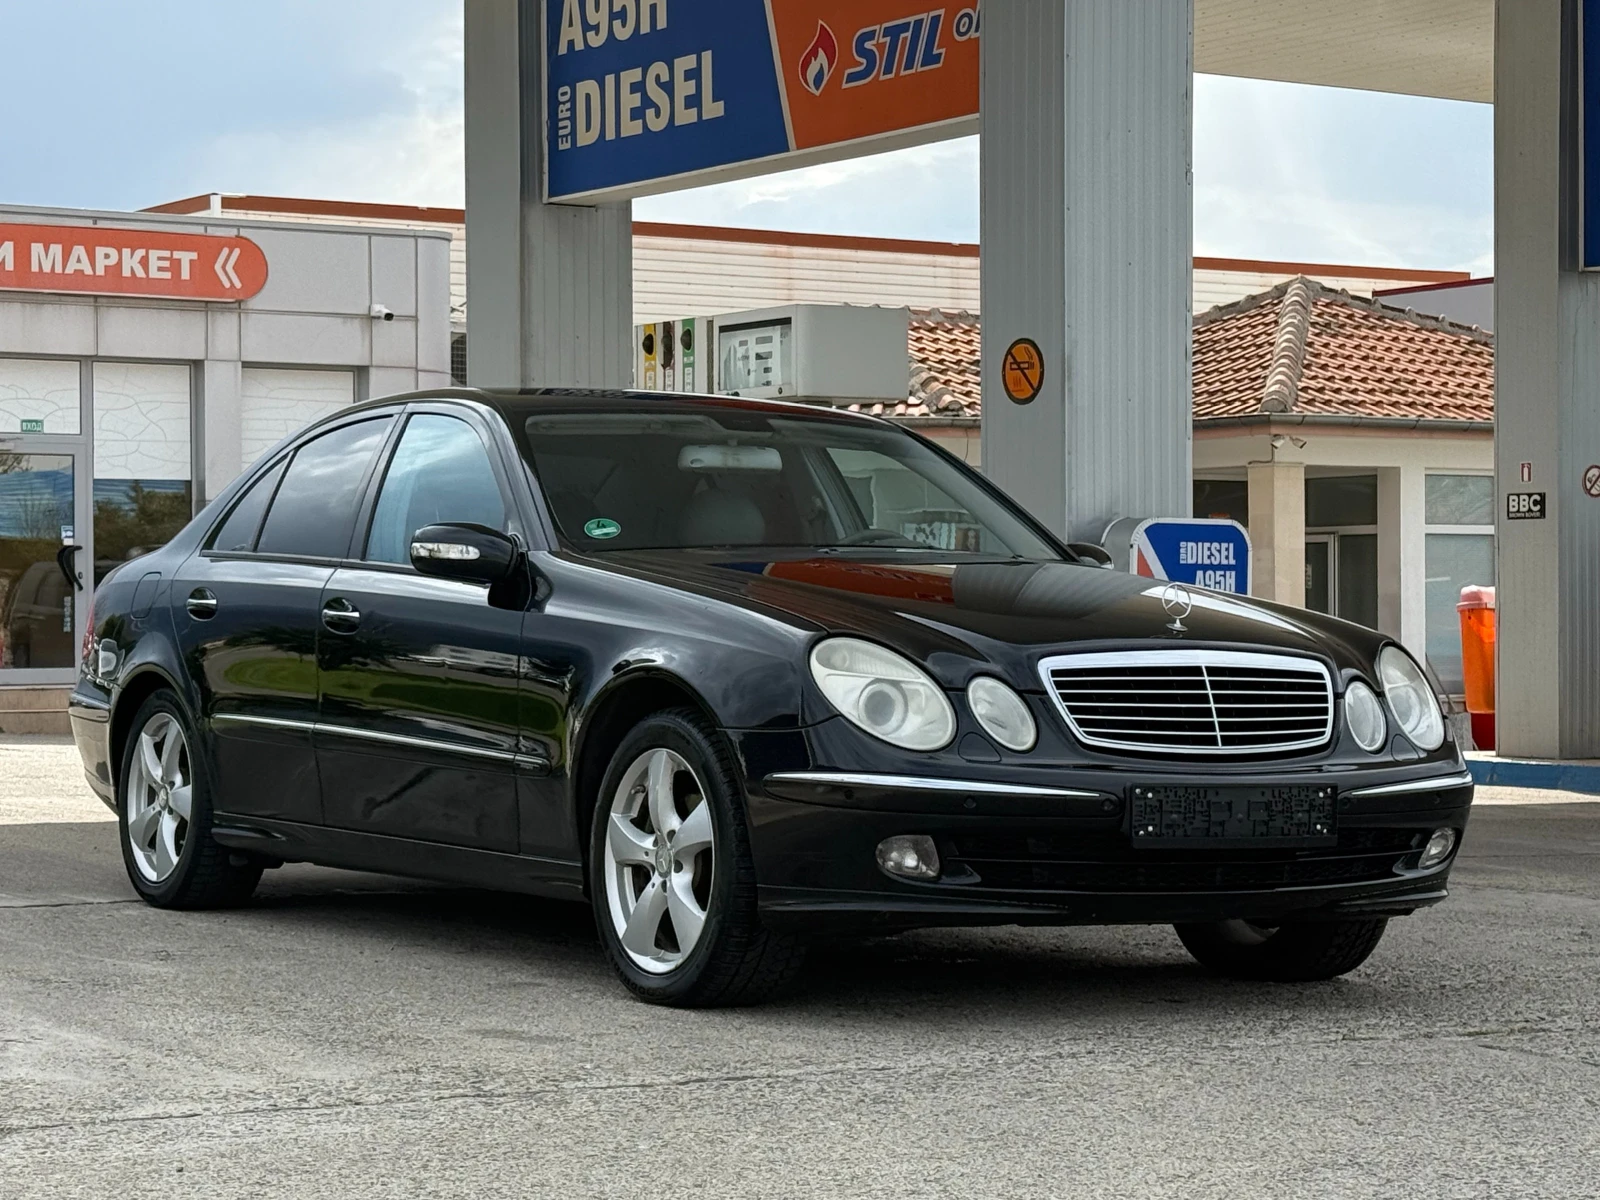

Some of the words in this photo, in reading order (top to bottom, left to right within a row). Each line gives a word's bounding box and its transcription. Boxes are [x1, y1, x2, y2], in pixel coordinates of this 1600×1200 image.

[842, 8, 946, 90] STIL
[558, 85, 572, 151] EURO
[575, 50, 725, 148] DIESEL
[30, 242, 198, 281] МАРКЕТ
[22, 421, 42, 431] ВХОД
[1508, 494, 1541, 512] BBC
[1187, 541, 1236, 565] DIESEL
